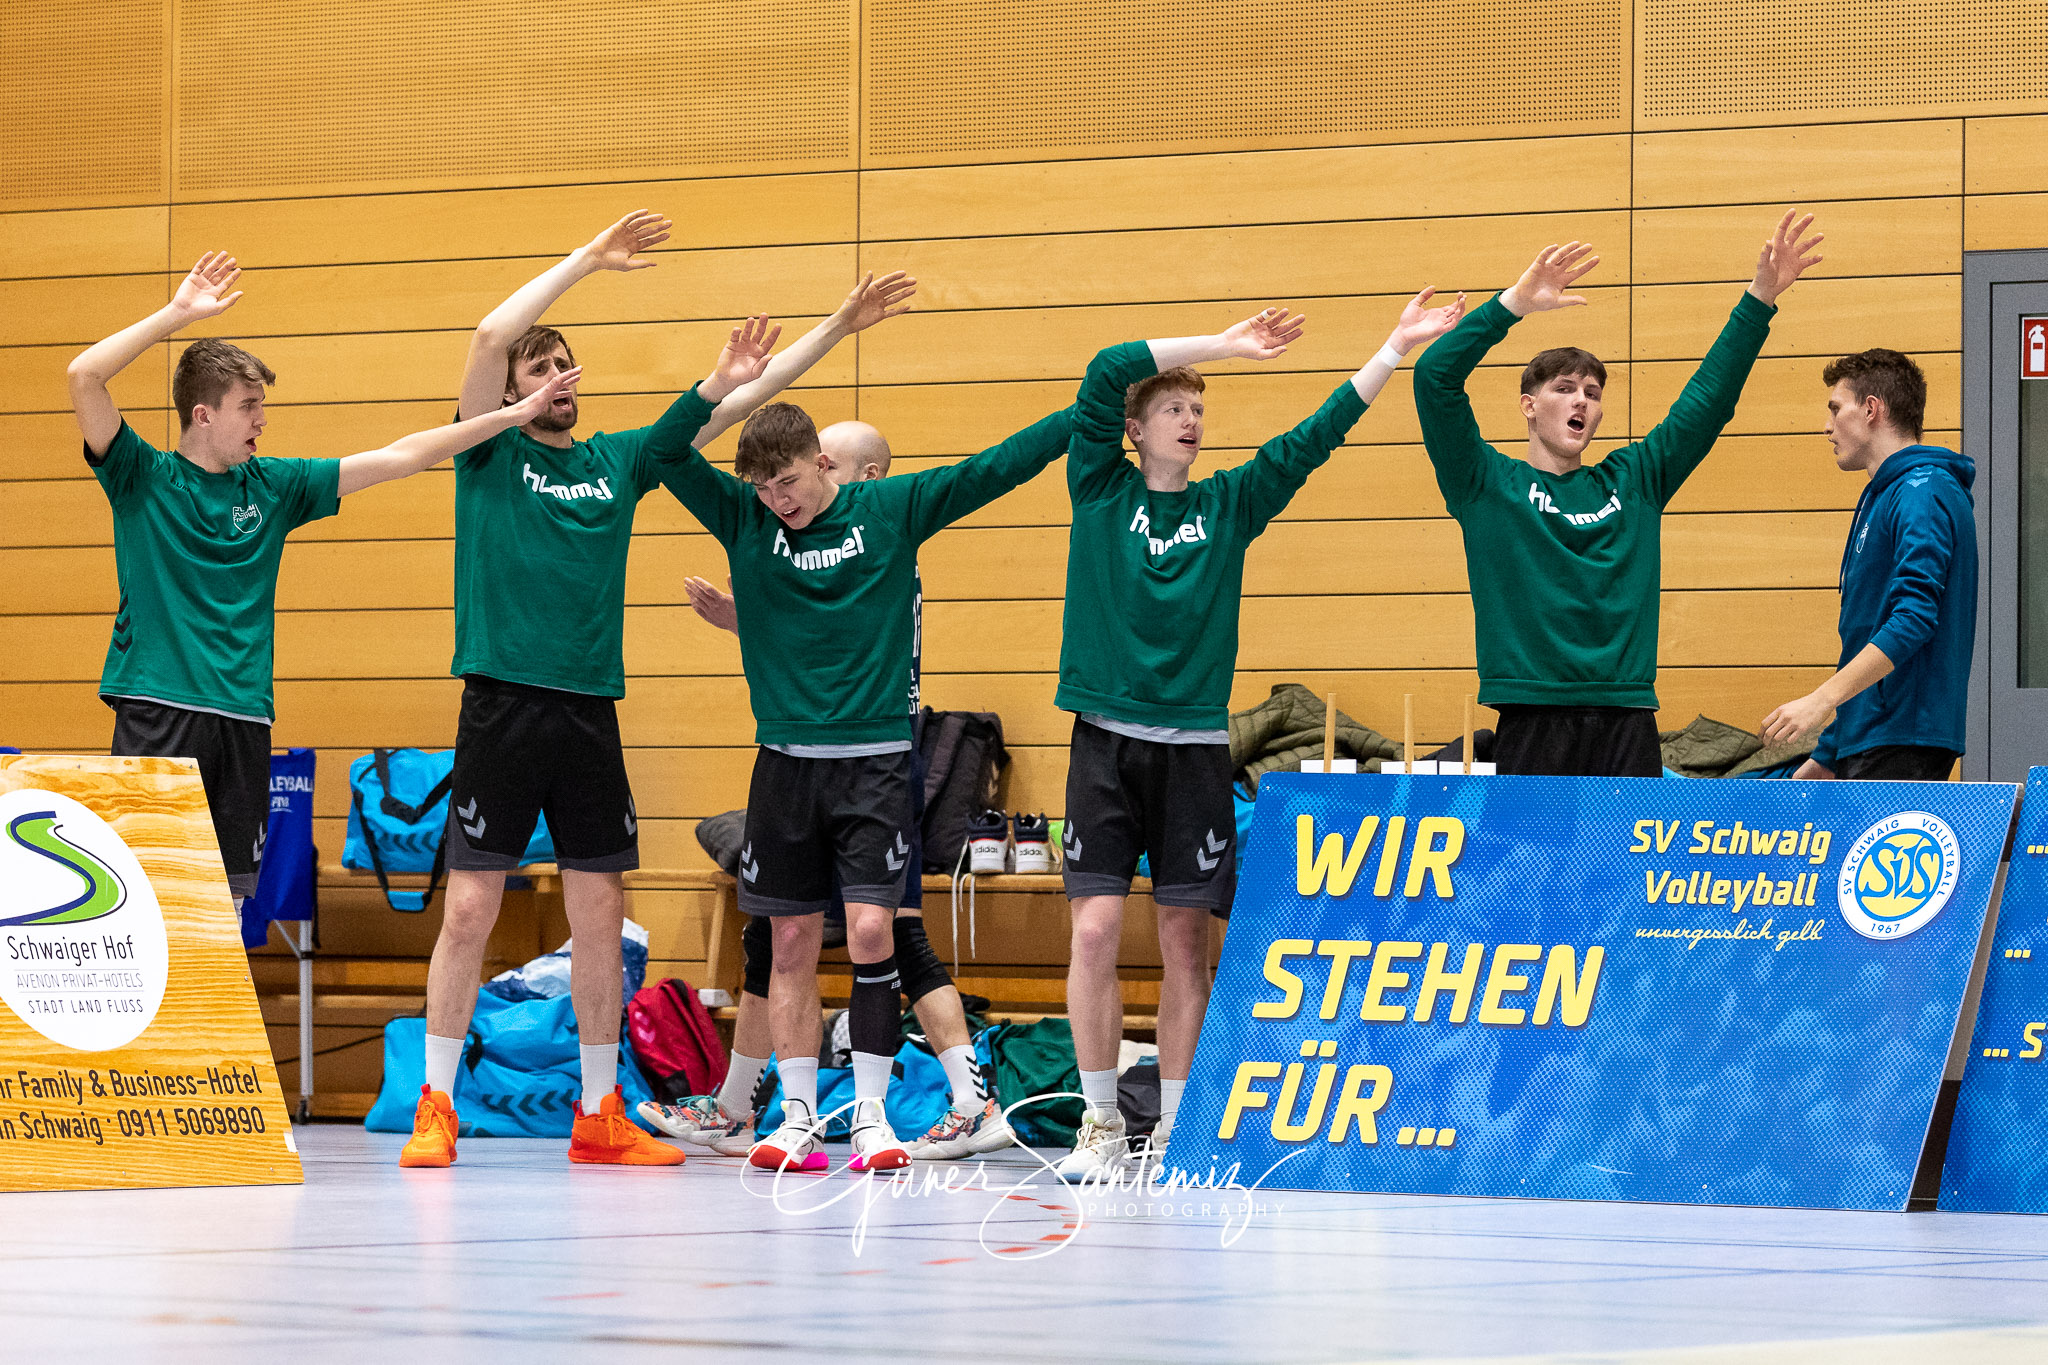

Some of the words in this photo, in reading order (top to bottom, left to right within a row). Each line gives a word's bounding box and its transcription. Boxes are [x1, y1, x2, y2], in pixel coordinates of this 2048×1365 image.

[1129, 505, 1207, 556] hmmel
[1296, 814, 1465, 898] WIR
[1629, 819, 1681, 854] SV
[1688, 820, 1832, 865] Schwaig
[1847, 819, 1900, 872] SCHWAIG
[1921, 818, 1955, 896] VOLLEYBALL
[1646, 870, 1819, 913] Volleyball
[1843, 878, 1852, 895] SV
[1635, 918, 1774, 950] unvergesslich
[1776, 918, 1825, 951] gelb
[1871, 923, 1900, 934] 1967
[7, 935, 97, 966] Schwaiger
[102, 935, 134, 959] Hof
[17, 974, 60, 988] AVENON
[62, 973, 144, 988] PRIVAT-HOTELS
[1252, 938, 1605, 1028] STEHEN
[28, 1000, 65, 1014] STADT
[70, 1000, 102, 1013] LAND
[107, 999, 144, 1013] FLUSS
[18, 1070, 83, 1105] Family
[88, 1069, 108, 1097] &
[109, 1066, 262, 1097] Business-Hotel
[19, 1111, 104, 1145] Schwaig
[116, 1108, 169, 1137] 0911
[174, 1106, 266, 1136] 5069890
